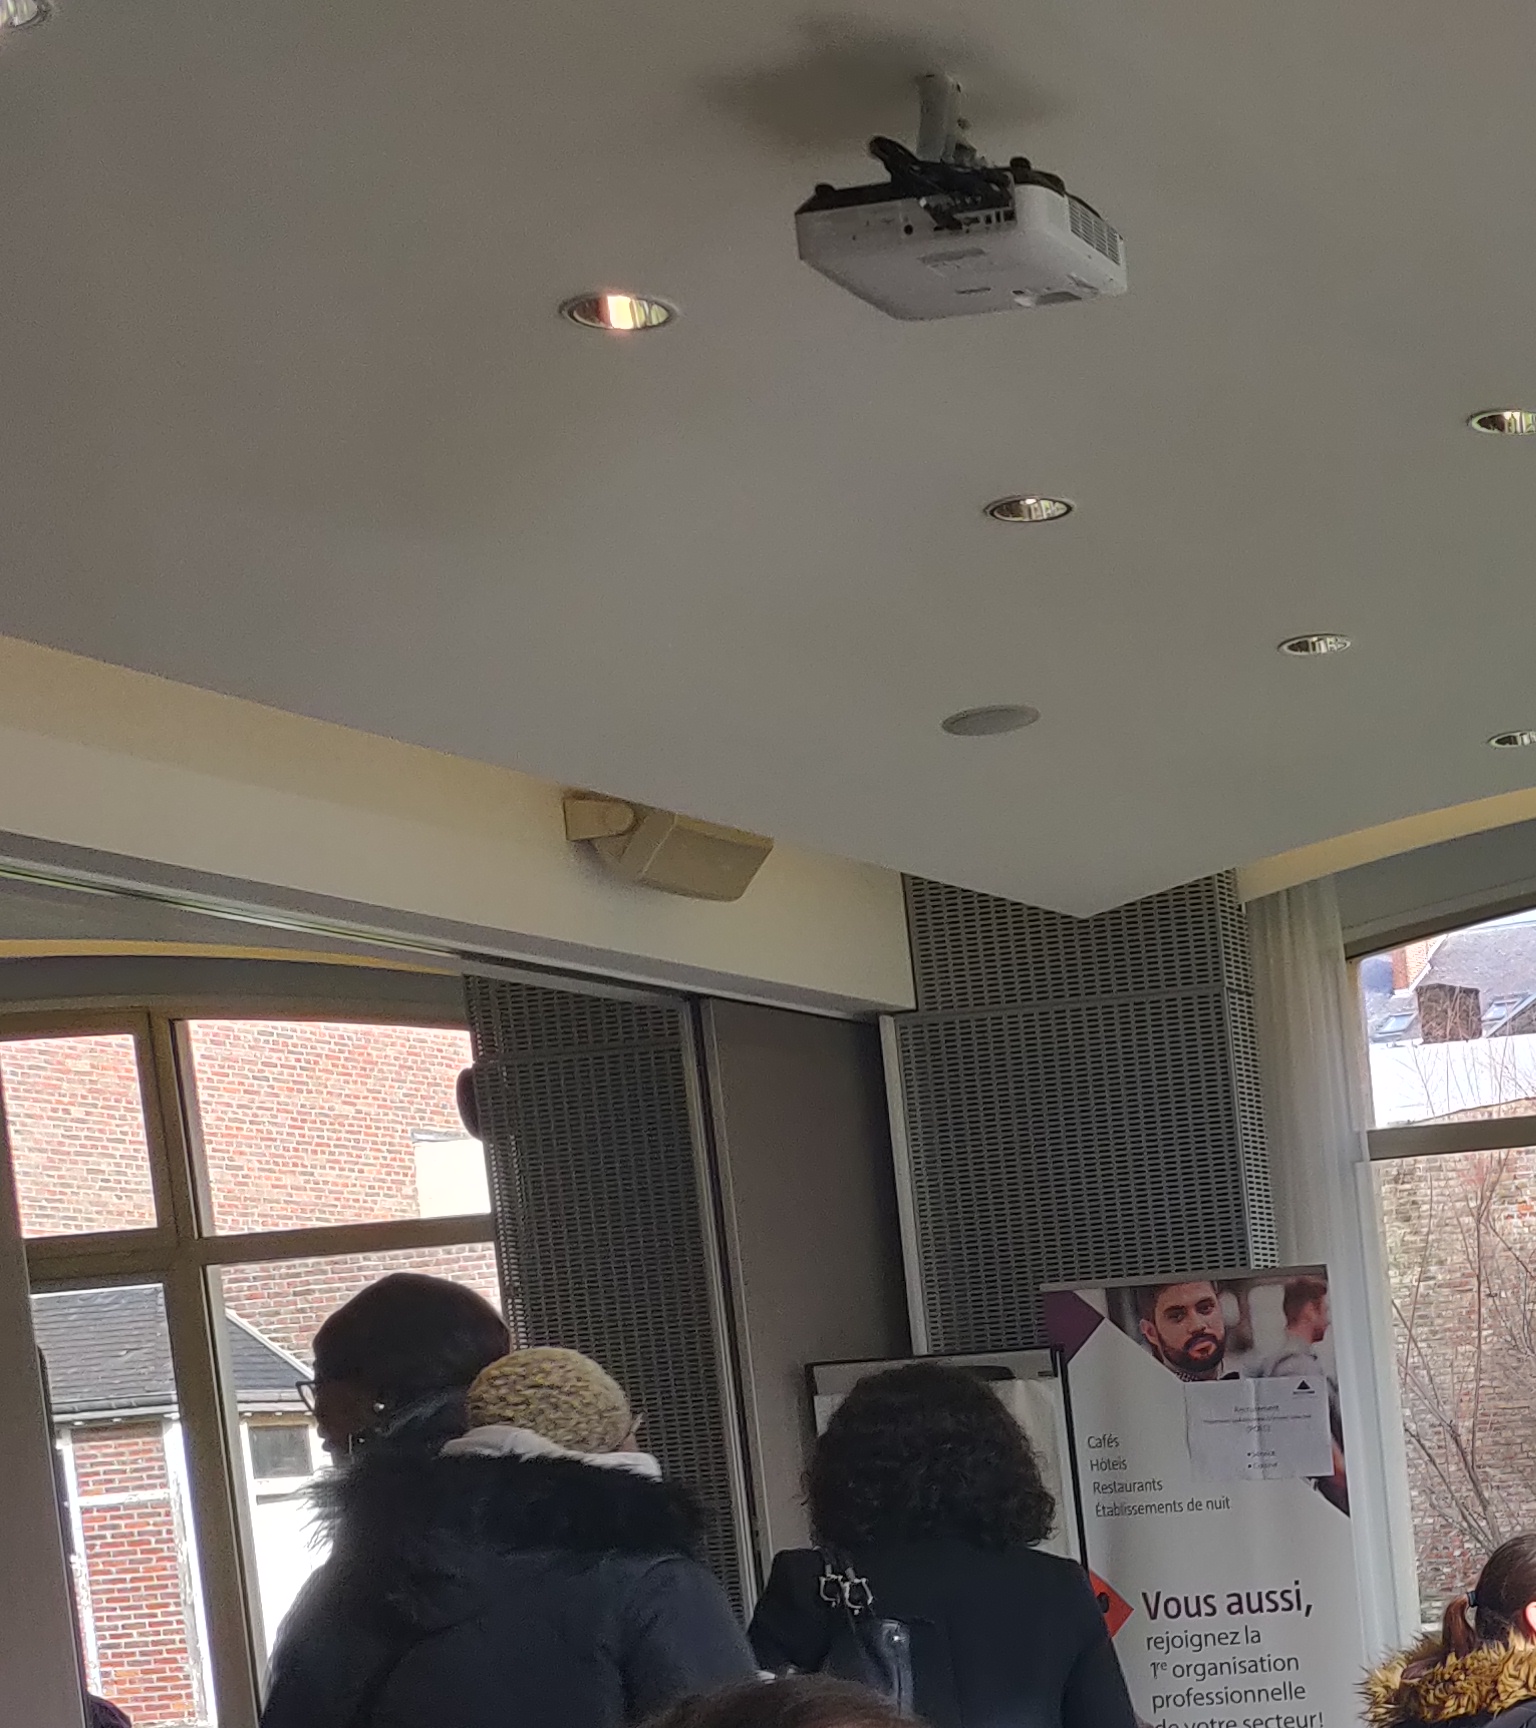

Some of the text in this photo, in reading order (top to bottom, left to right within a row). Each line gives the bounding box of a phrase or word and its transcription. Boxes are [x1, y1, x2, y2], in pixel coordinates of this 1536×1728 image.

[1087, 1433, 1119, 1449] Cafés
[1093, 1478, 1163, 1494] Restaurants
[1096, 1495, 1231, 1517] Établissements de nuit
[1141, 1580, 1313, 1620] Vous aussi,
[1146, 1625, 1262, 1655] rejoignez la
[1172, 1653, 1299, 1682] organisation
[1152, 1681, 1306, 1714] professionnelle
